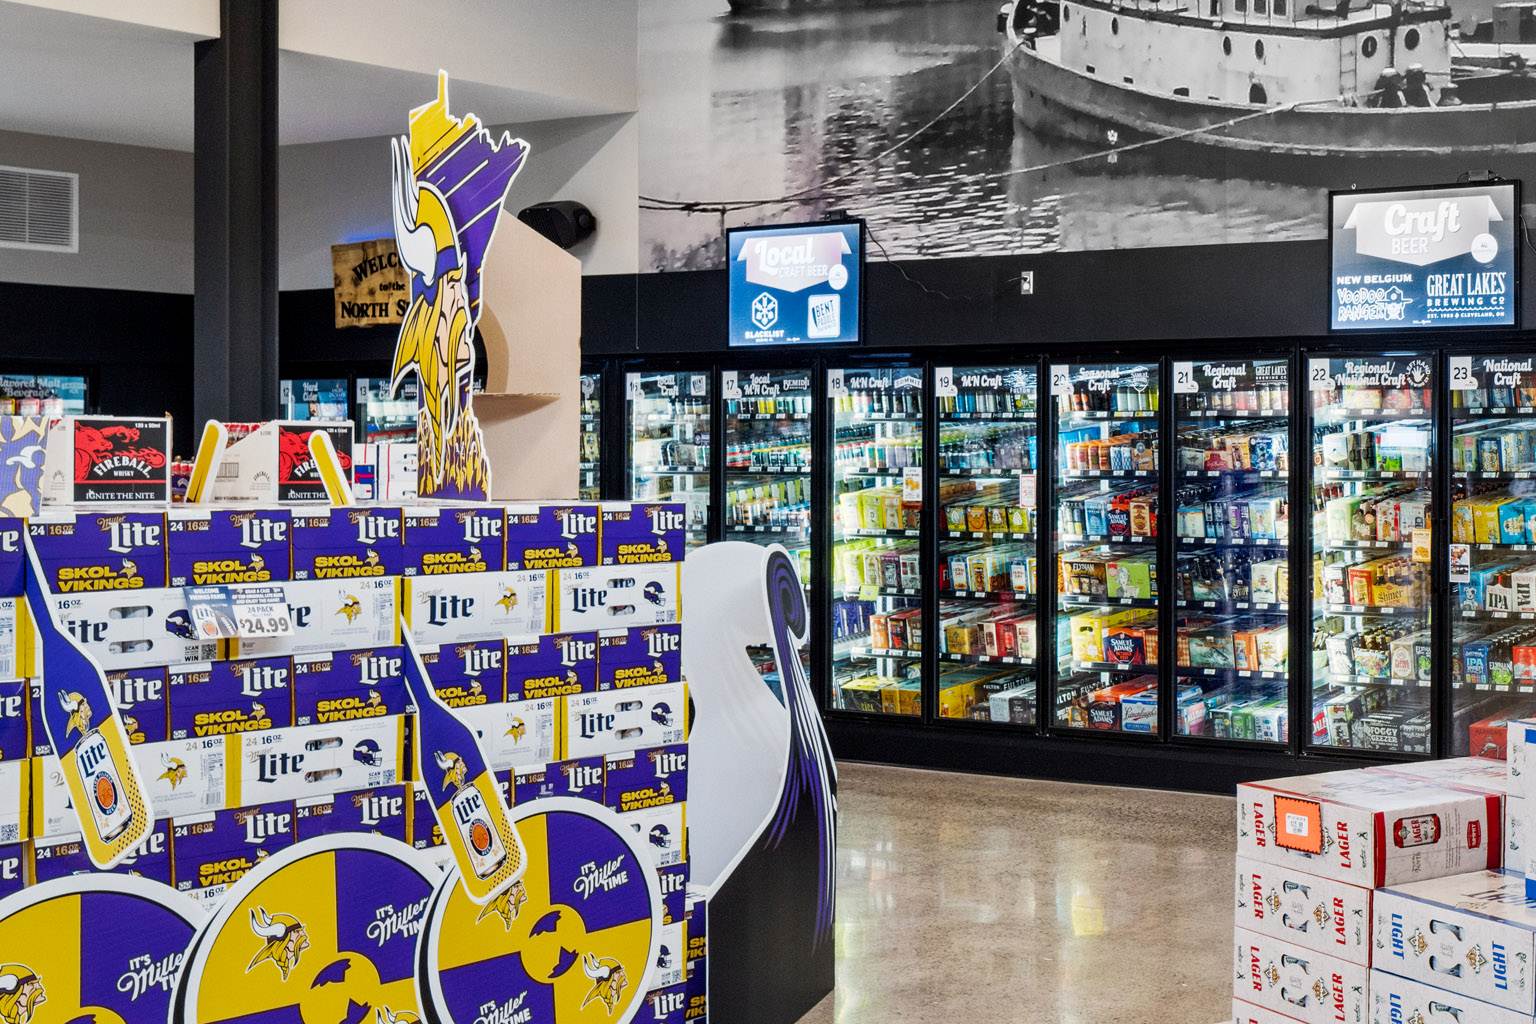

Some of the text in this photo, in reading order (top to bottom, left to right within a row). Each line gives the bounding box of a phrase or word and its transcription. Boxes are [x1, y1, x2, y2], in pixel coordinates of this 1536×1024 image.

[1384, 201, 1463, 242] Craft
[1391, 237, 1429, 255] BEER
[755, 236, 817, 275] Local
[352, 252, 404, 283] WELC
[1336, 273, 1413, 286] NEW BELGIUM
[1426, 271, 1507, 297] GREAT LAKES
[1337, 287, 1385, 305] VOODOO
[1427, 298, 1484, 307] BREWING
[340, 301, 390, 319] NORTH
[815, 299, 835, 318] BENT
[1202, 364, 1246, 379] Regional
[1344, 360, 1395, 376] Regional/
[1453, 367, 1468, 380] 23
[1483, 358, 1533, 373] National
[750, 373, 771, 384] Local
[938, 376, 949, 388] 19
[961, 374, 1003, 389] MN Craft
[1177, 371, 1189, 384] 21
[1212, 375, 1237, 390] Craft
[1312, 368, 1326, 381] 22
[1335, 373, 1379, 387] National
[1380, 371, 1407, 388] Craft
[1494, 371, 1521, 387] Craft
[761, 383, 780, 397] Craft
[831, 378, 841, 389] 18
[850, 378, 868, 388] MN
[93, 454, 151, 479] FIREBALL
[113, 469, 135, 478] WHISKY
[86, 489, 155, 500] IGNITE THE NITE
[31, 525, 45, 536] 24
[170, 522, 184, 532] 24
[240, 517, 287, 549] Lite
[356, 515, 399, 545] Lite
[463, 515, 502, 544] Lite
[108, 521, 161, 554] Lite
[58, 566, 118, 580] SKOL
[193, 561, 247, 574] SKOL
[58, 576, 144, 592] VIKINGS
[193, 570, 271, 585] VIKINGS
[1488, 593, 1509, 610] IPA
[427, 595, 475, 627] Lite
[240, 617, 289, 634] $24.99
[1370, 726, 1398, 736] FOGGY
[1370, 734, 1398, 744] GEEZER
[1253, 801, 1267, 848] LAGER
[1336, 821, 1352, 869] LAGER
[580, 860, 595, 874] IT'S
[574, 854, 625, 900] Miller
[601, 874, 629, 892] TIME
[1391, 913, 1406, 961] LIGHT
[1492, 940, 1508, 990] LIGHT
